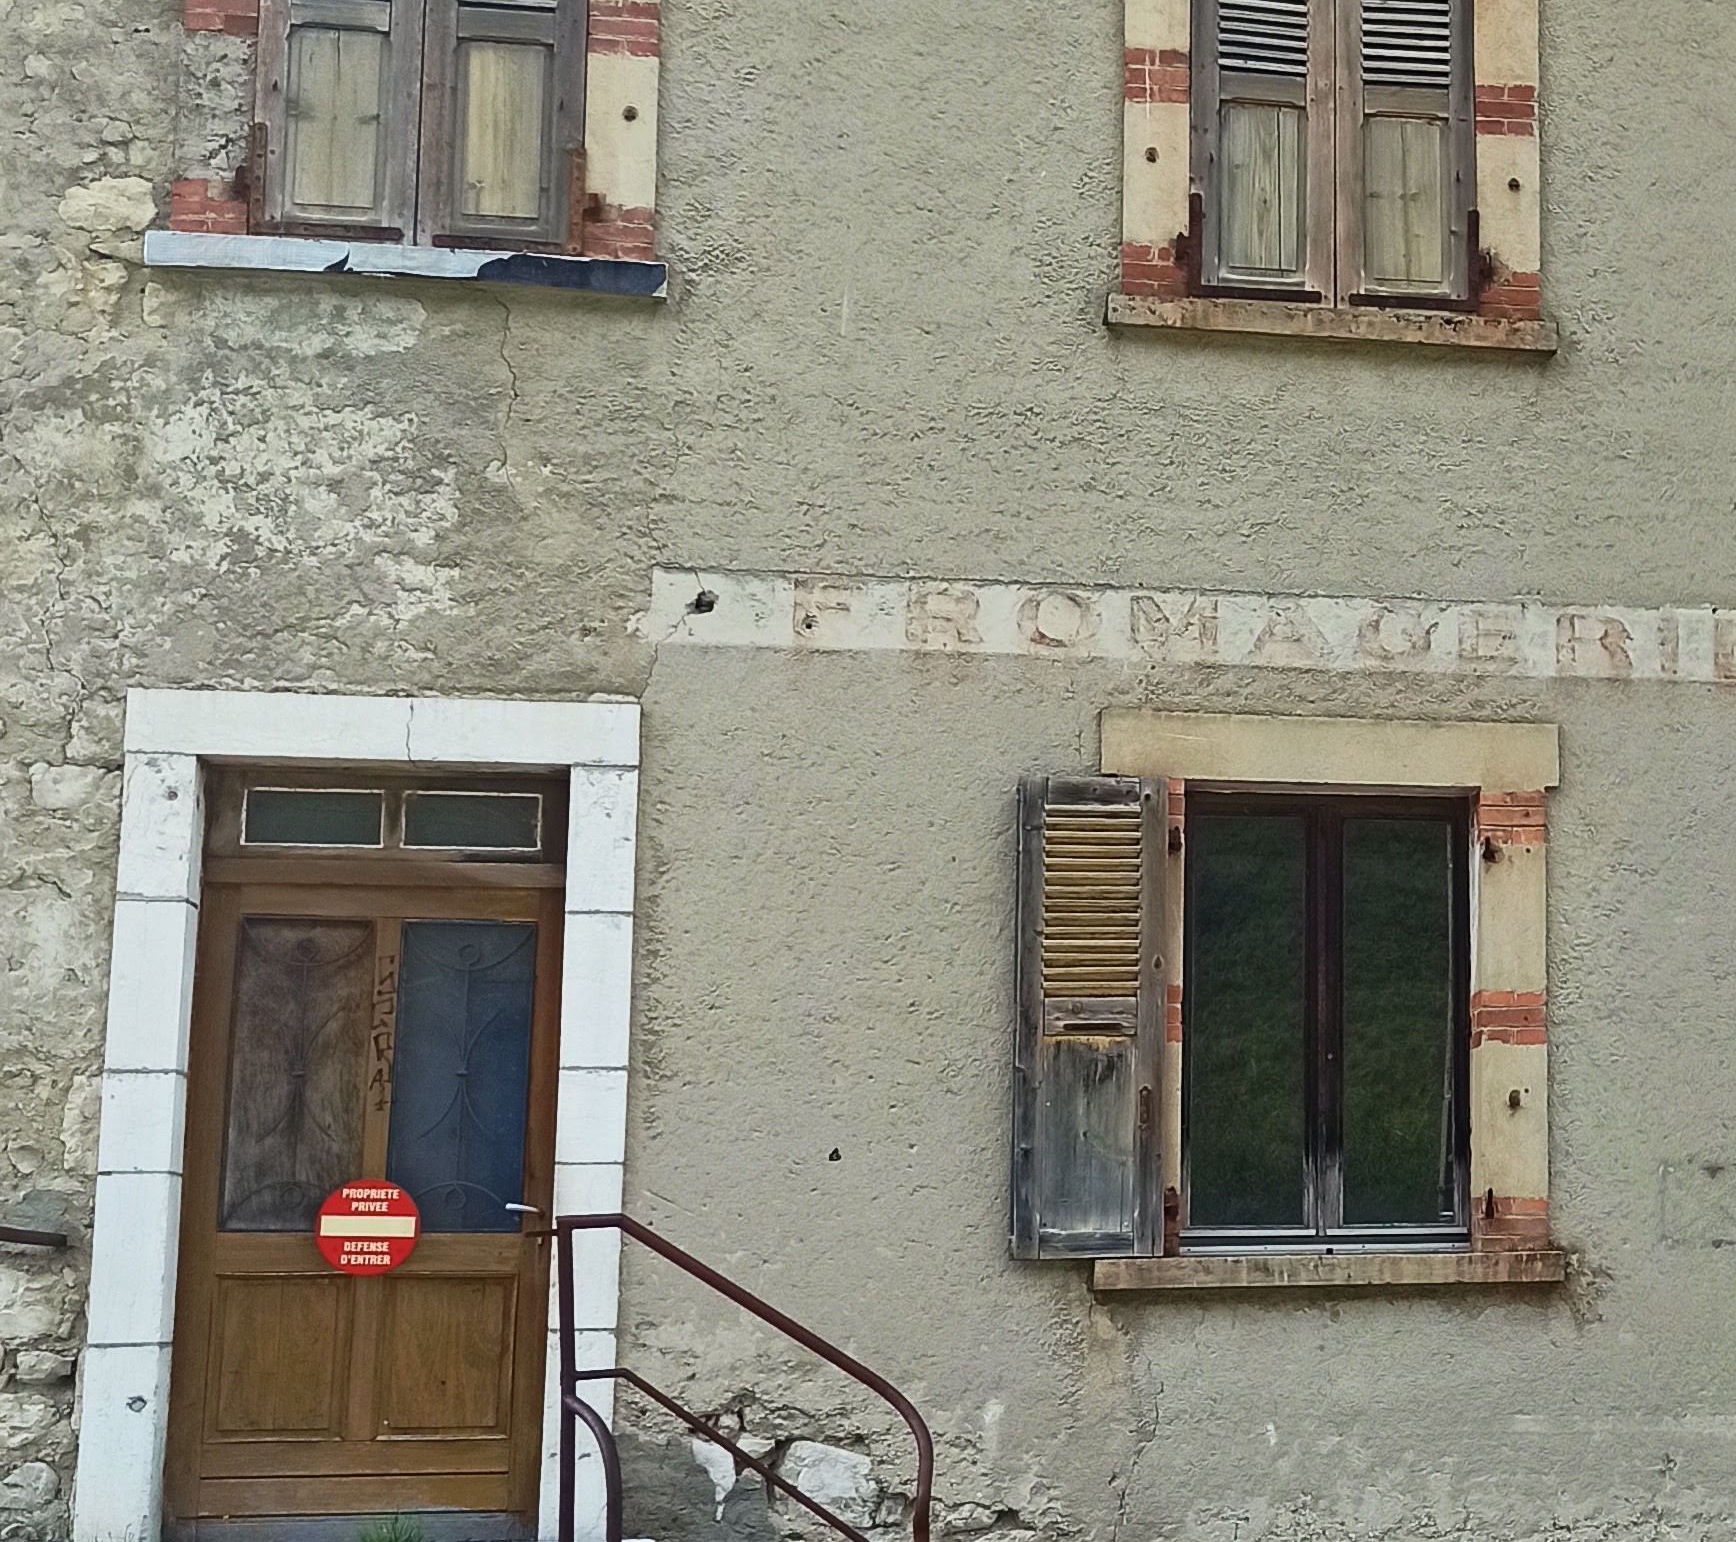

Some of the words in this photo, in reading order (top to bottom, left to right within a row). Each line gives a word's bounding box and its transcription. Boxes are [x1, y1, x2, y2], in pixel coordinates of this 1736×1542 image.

[342, 1188, 400, 1199] PROPRIETE
[351, 1201, 389, 1212] PRIVEE
[343, 1241, 390, 1252] DEFENSE
[340, 1254, 391, 1265] D'ENTRER
